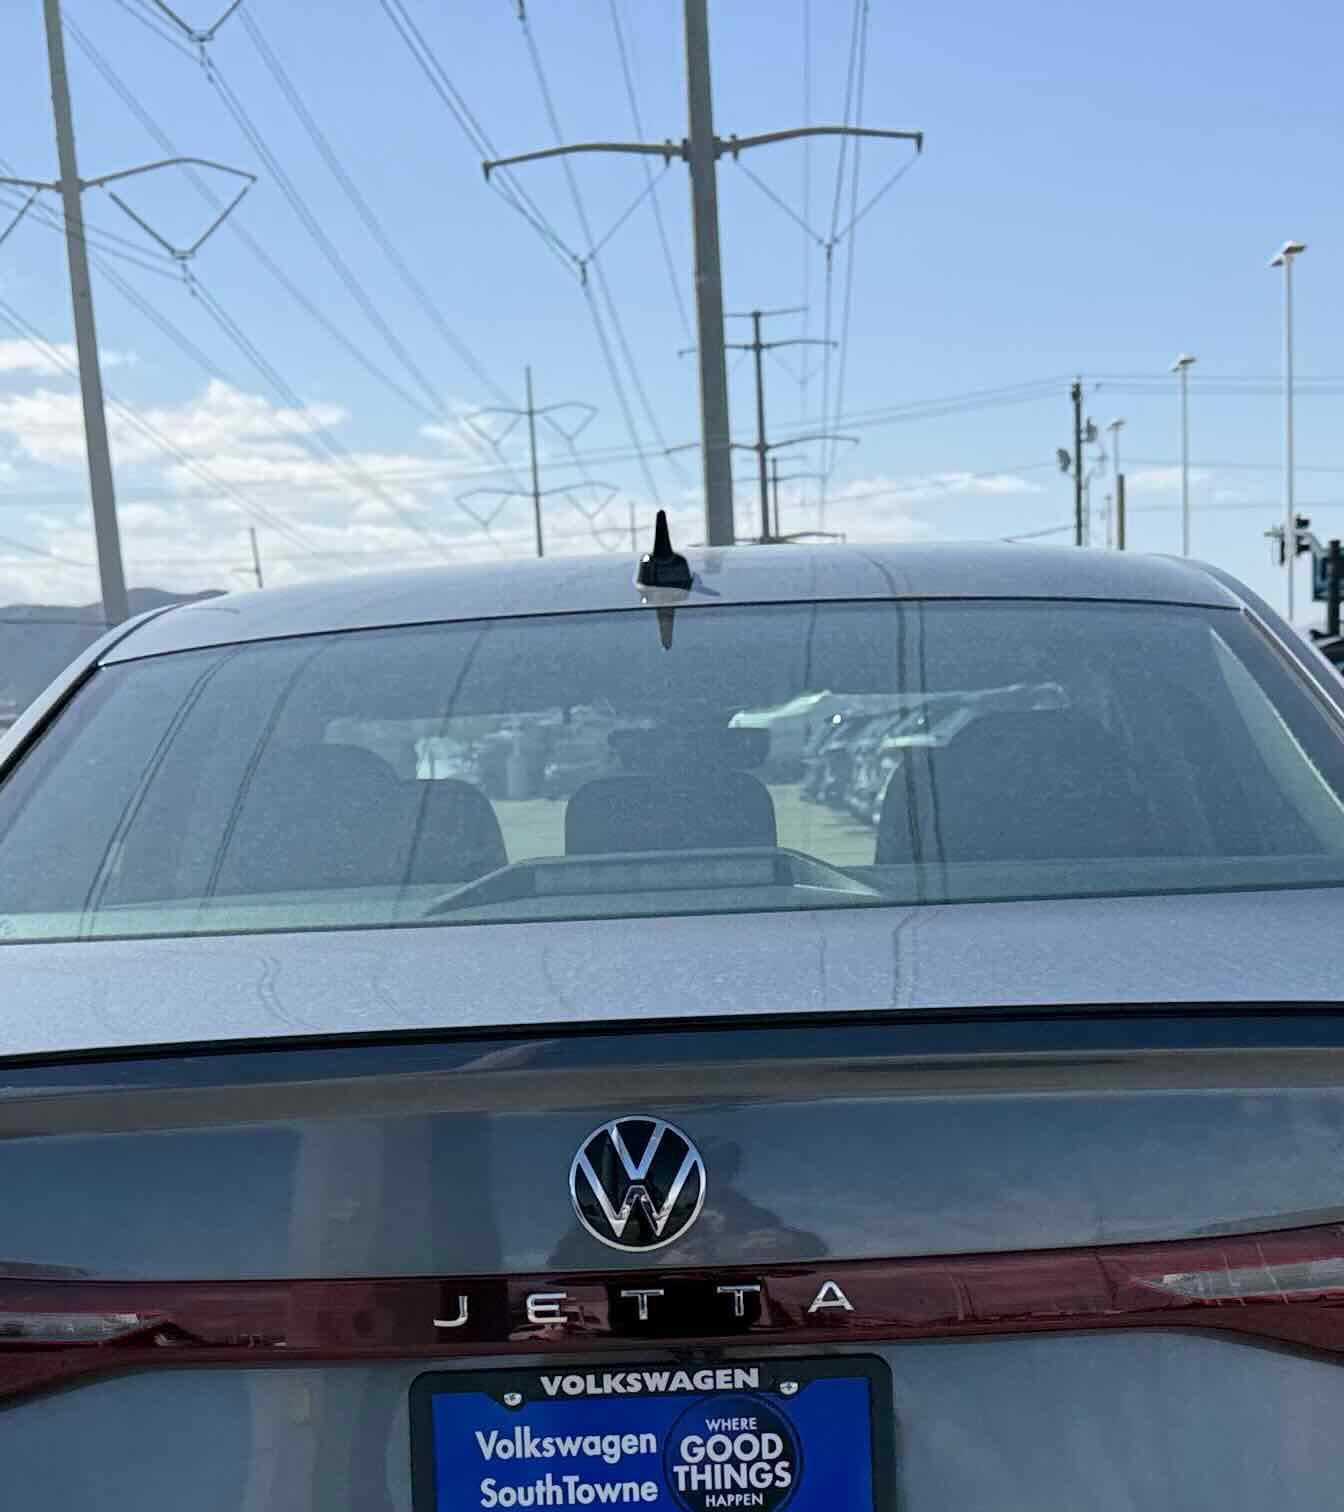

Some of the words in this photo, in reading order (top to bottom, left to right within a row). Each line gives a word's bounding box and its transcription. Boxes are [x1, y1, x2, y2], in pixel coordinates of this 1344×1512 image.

[433, 1280, 854, 1328] JETTA
[540, 1368, 760, 1396] VOLKSWAGEN
[705, 1417, 758, 1431] WHERE
[475, 1426, 657, 1464] Volkswagen
[680, 1433, 784, 1464] GOOD
[672, 1461, 792, 1491] THINGS
[705, 1493, 764, 1508] HAPPEN
